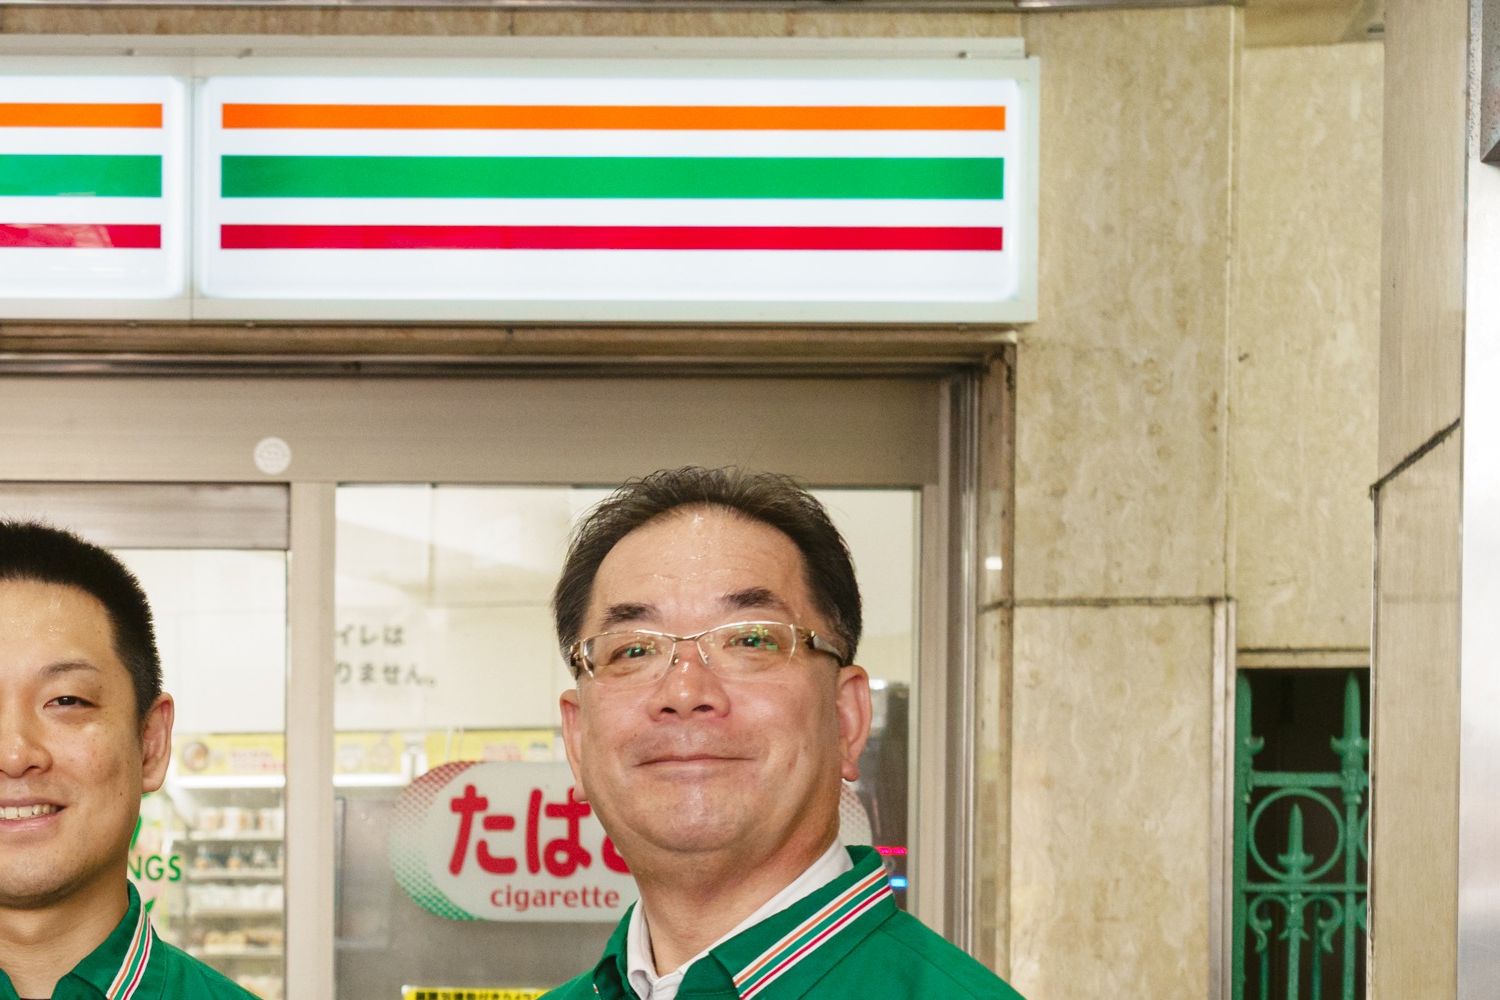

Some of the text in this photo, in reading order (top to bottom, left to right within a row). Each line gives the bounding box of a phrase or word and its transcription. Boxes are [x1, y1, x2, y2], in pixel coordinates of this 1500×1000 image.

[336, 662, 438, 687] りません。
[490, 884, 620, 913] cigarette
